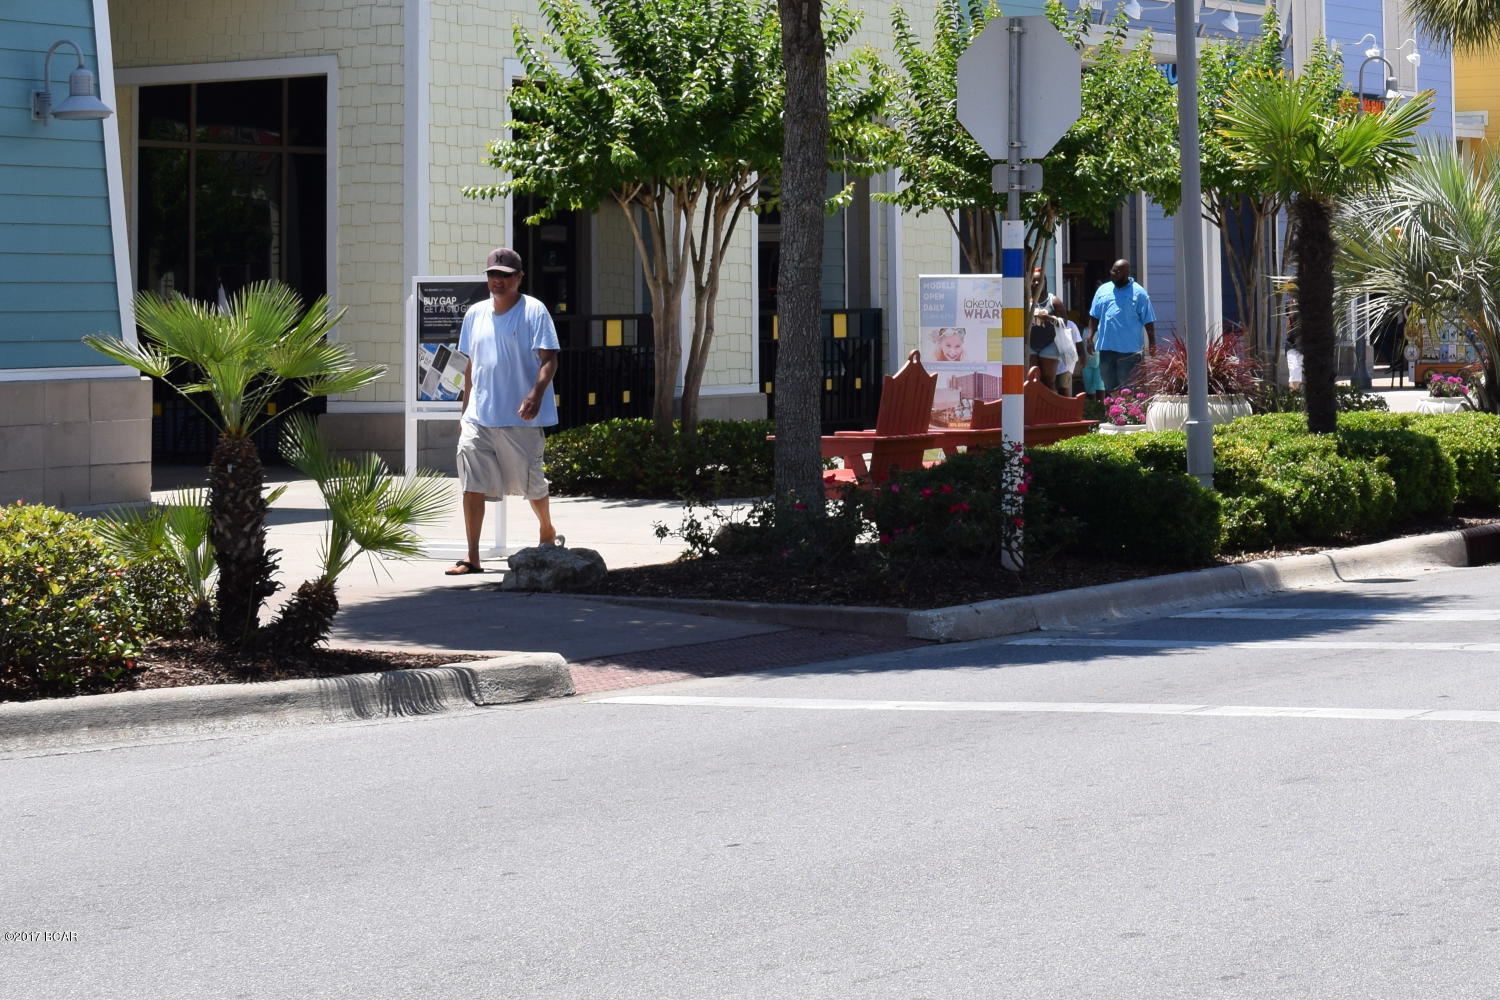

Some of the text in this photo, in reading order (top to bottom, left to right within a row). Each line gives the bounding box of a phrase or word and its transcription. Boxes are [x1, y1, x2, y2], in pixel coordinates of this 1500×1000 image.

[923, 282, 956, 290] MODELS
[424, 296, 457, 305] BUY GAP
[923, 292, 945, 301] OPEN
[964, 298, 1003, 308] laketow
[423, 305, 438, 313] GET
[439, 305, 445, 313] A
[923, 304, 945, 312] DAILY
[964, 309, 1002, 320] WHAR
